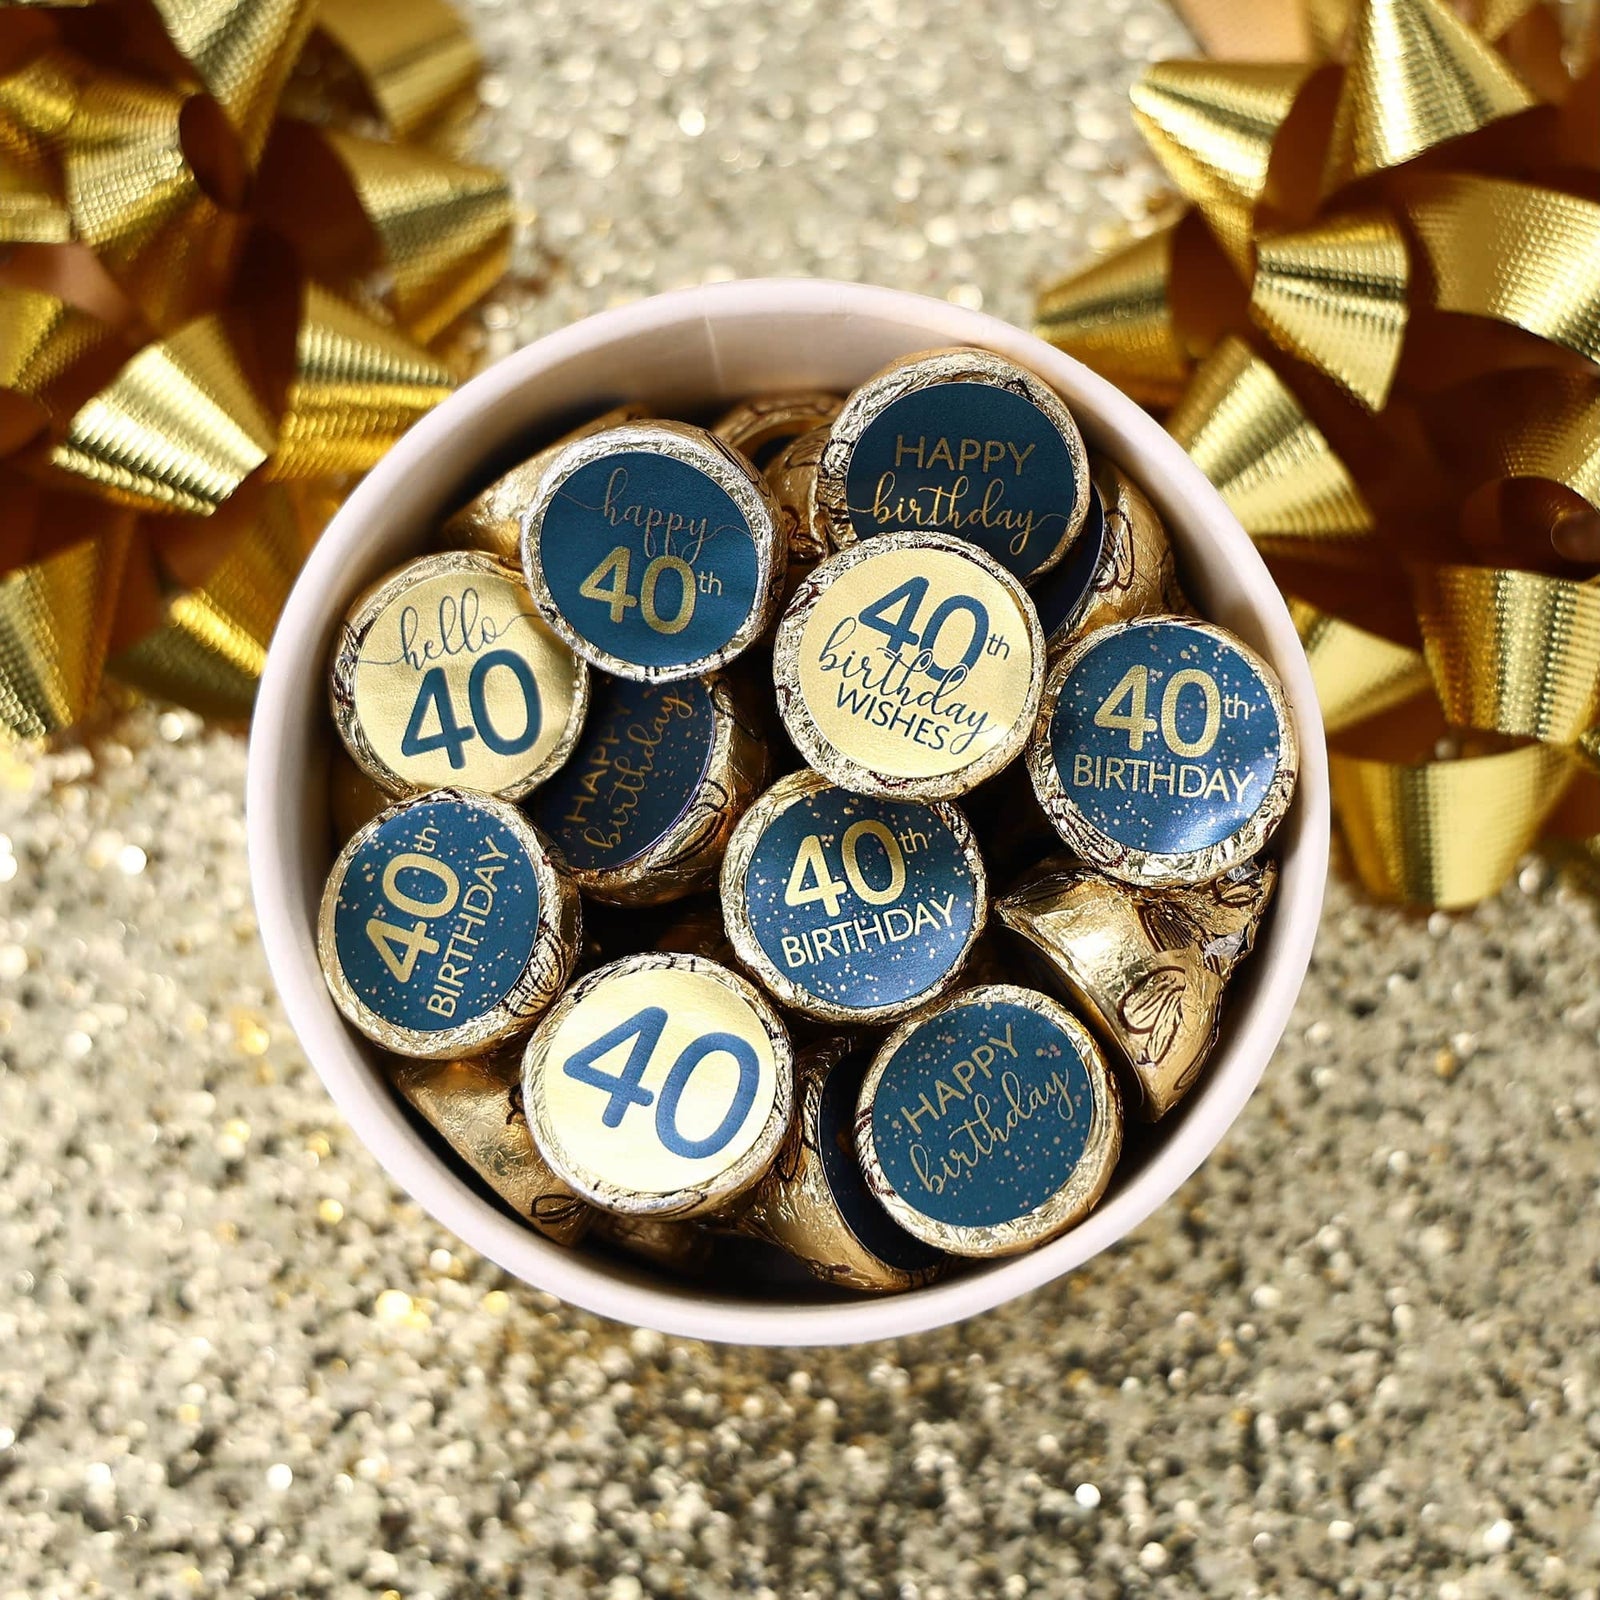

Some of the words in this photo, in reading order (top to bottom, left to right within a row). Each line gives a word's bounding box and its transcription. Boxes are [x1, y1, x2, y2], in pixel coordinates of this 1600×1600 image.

[894, 434, 1036, 477] HAPPY
[558, 467, 755, 566] happy
[847, 471, 1074, 556] birthday
[358, 586, 541, 671] hello
[578, 545, 723, 636] 40th
[857, 575, 1013, 682] 40th
[401, 648, 543, 771] 40
[818, 617, 999, 755] birthday
[835, 682, 949, 752] WISHES
[1093, 664, 1250, 759] 40th
[583, 687, 693, 849] birthday
[1073, 753, 1255, 804] BIRTHDAY
[365, 825, 461, 984] 40th
[783, 819, 929, 918] 40th
[426, 835, 509, 1019] BIRTHDAY
[780, 894, 958, 969] BIRTHDAY
[562, 1005, 760, 1160] 40
[900, 1022, 1021, 1135] HAPPY
[909, 1066, 1071, 1195] birthday
